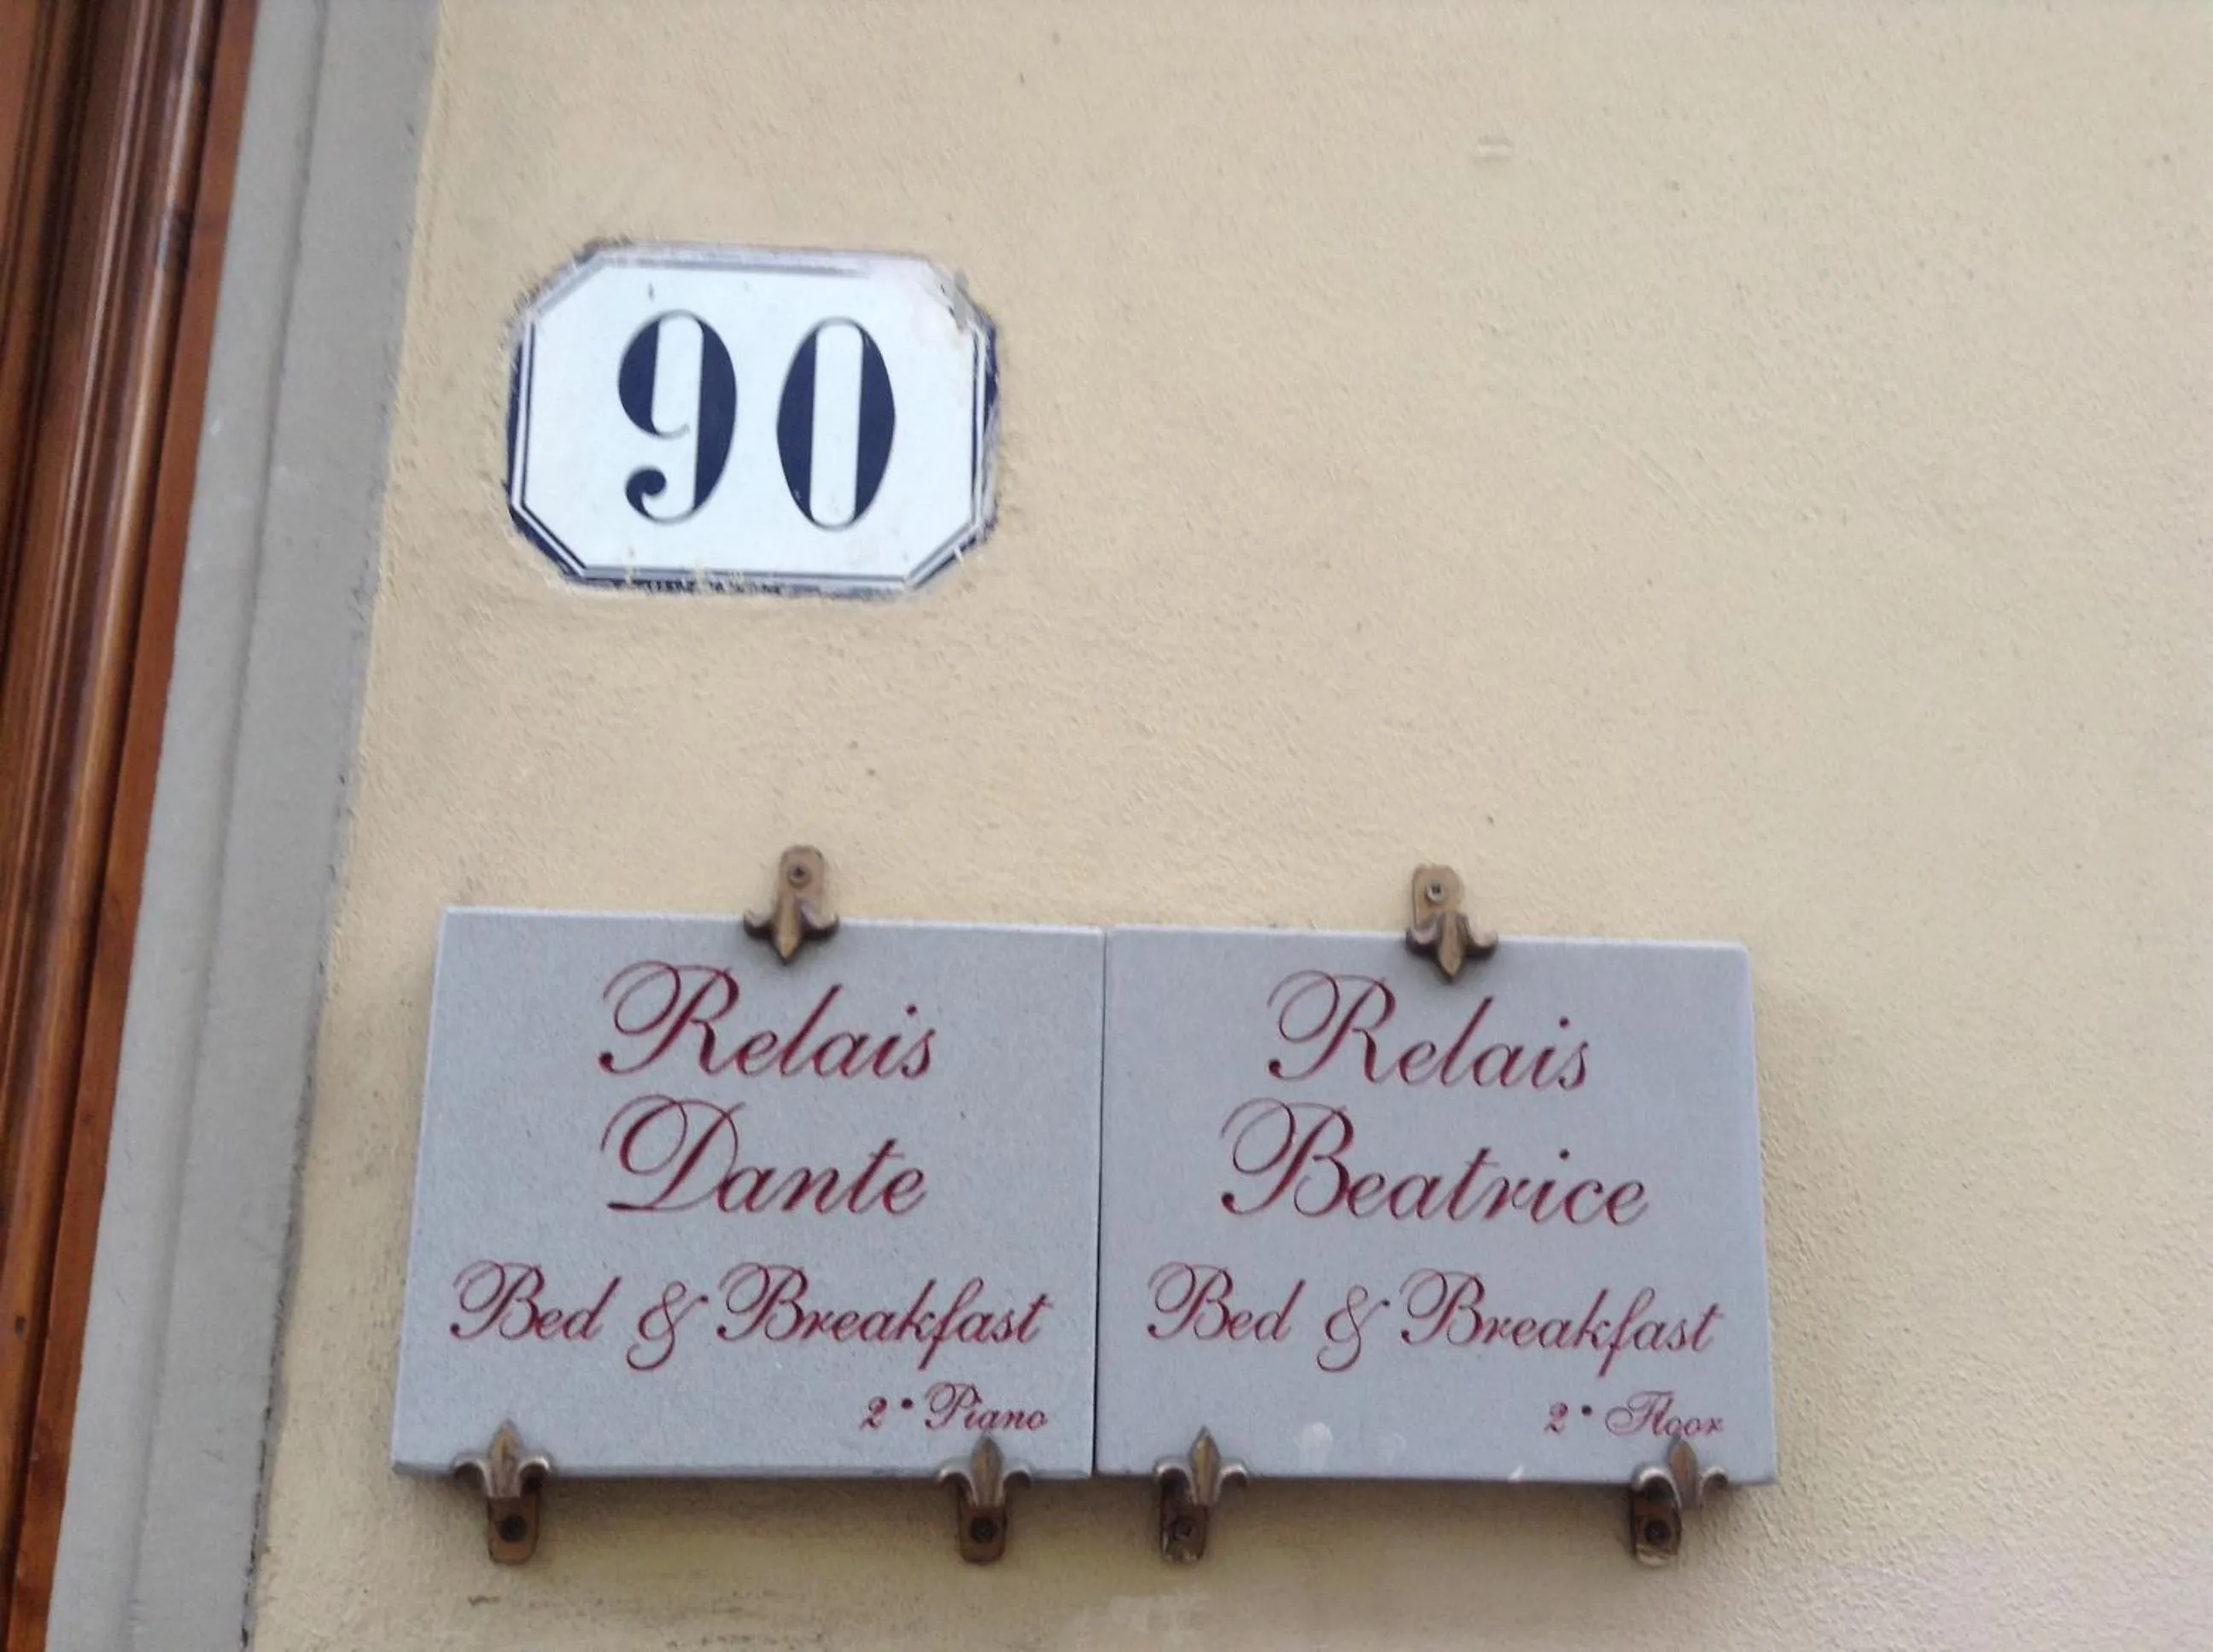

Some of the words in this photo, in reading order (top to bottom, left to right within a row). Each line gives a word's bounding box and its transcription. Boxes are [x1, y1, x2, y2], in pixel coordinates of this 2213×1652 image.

[617, 308, 896, 533] 90
[597, 959, 937, 1078] Relais
[1266, 969, 1591, 1092] Relais
[599, 1093, 929, 1217] Dante
[1219, 1096, 1651, 1227] Beatrice
[449, 1259, 623, 1342] Bed
[625, 1280, 709, 1372] &
[715, 1261, 1054, 1370] Breakfast
[1146, 1260, 1307, 1342] Bed
[1316, 1284, 1391, 1374] &
[1398, 1267, 1726, 1379] Breakfast
[924, 1380, 1049, 1432] Piano
[1604, 1389, 1725, 1438] Floor
